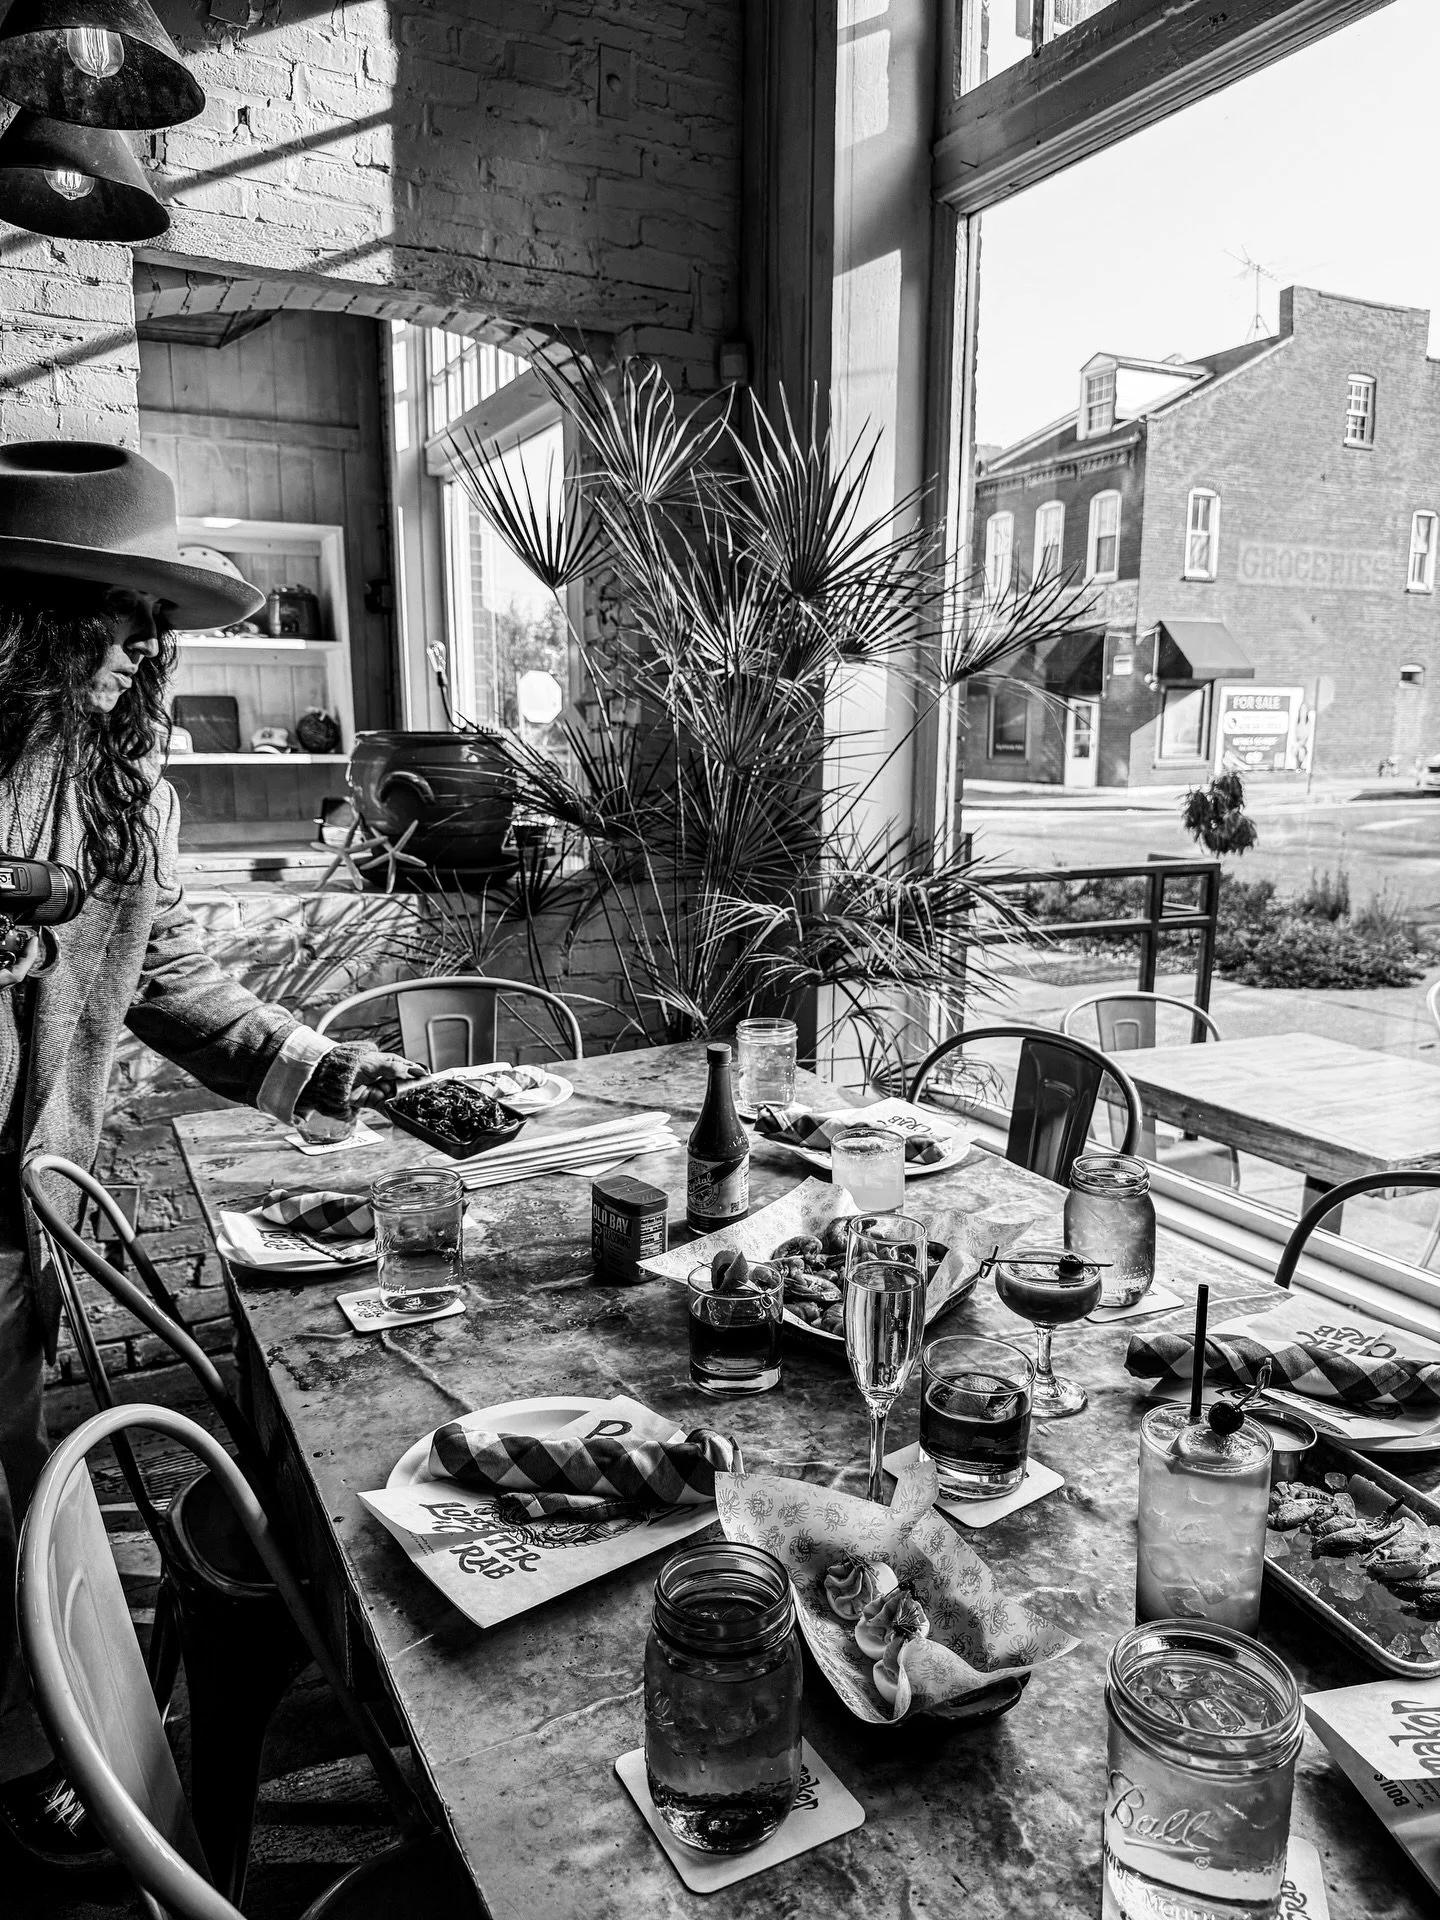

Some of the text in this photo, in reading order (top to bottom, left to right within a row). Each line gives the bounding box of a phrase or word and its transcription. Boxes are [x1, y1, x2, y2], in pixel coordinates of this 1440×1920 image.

[1242, 547, 1391, 586] GROCERIES
[1232, 696, 1281, 710] FOR SALE
[593, 1203, 629, 1234] OLD BAY
[1373, 1774, 1410, 1807] BOILS
[1110, 1769, 1211, 1852] Ball
